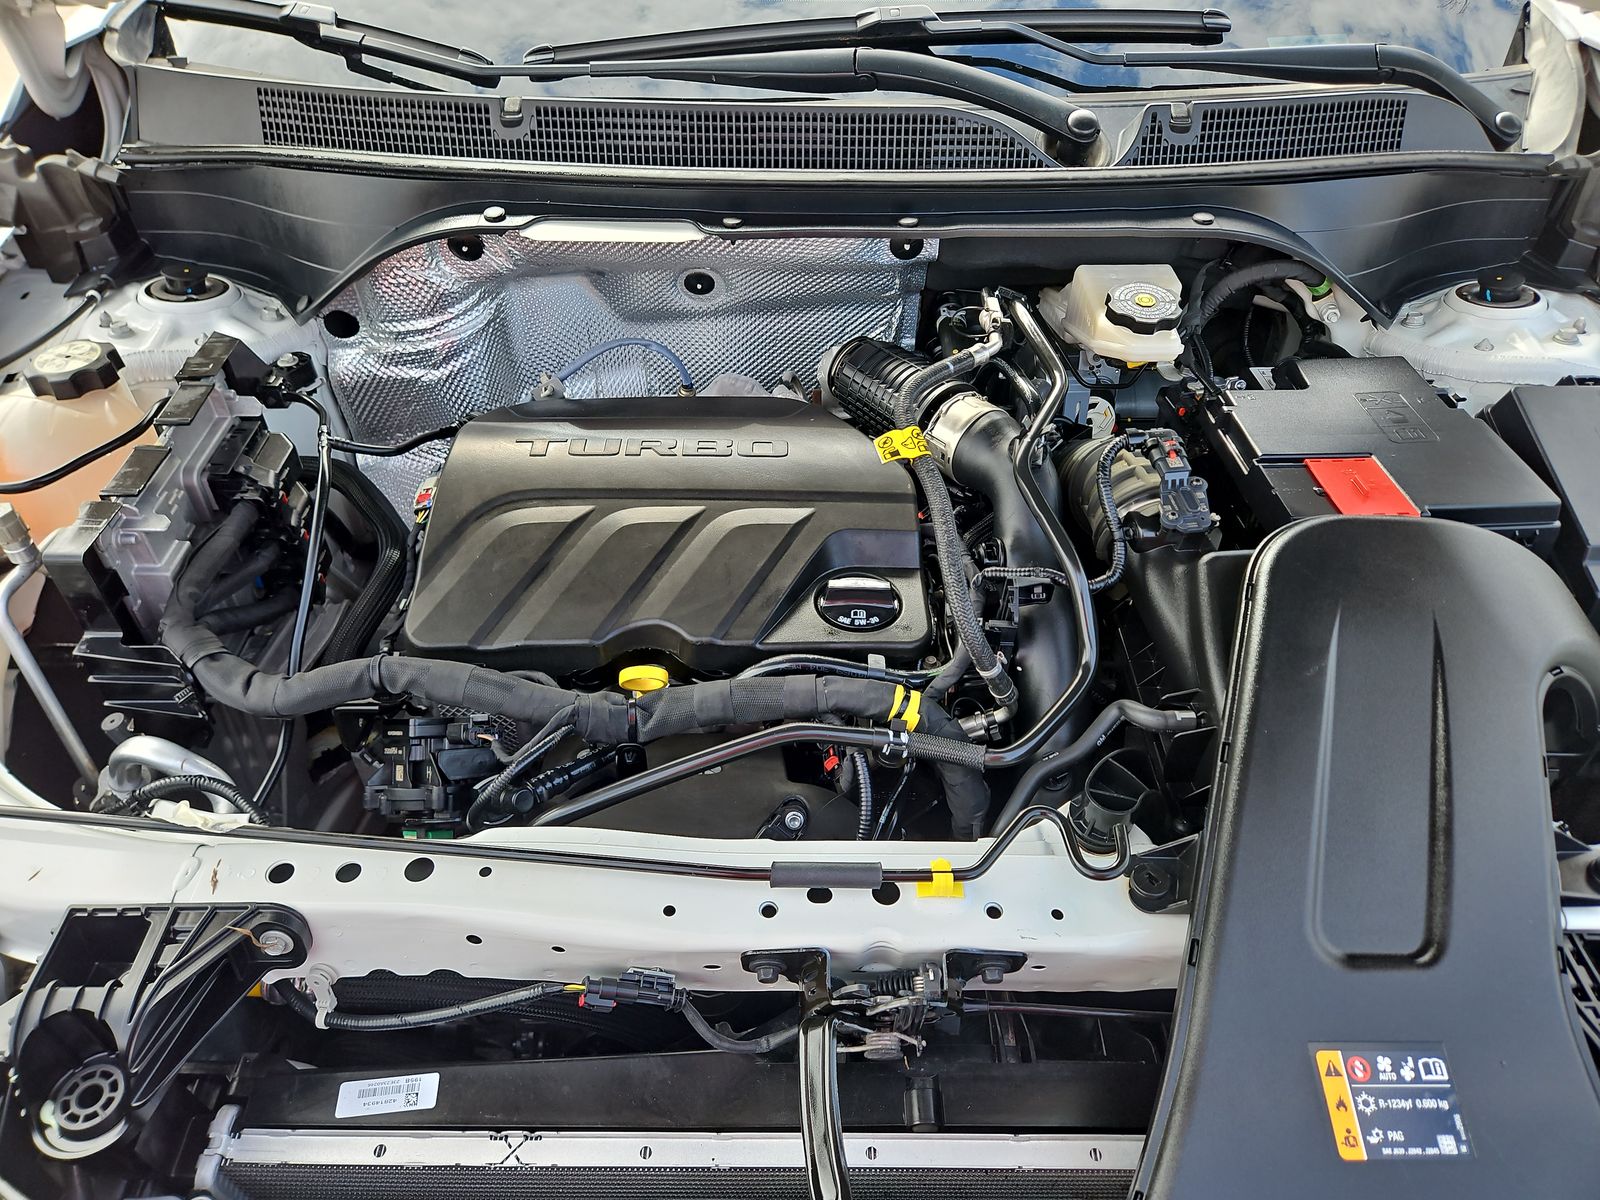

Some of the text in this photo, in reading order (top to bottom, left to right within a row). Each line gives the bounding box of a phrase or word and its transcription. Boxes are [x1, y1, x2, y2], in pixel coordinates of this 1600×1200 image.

[515, 438, 789, 457] TURBO
[837, 615, 880, 626] SAE 5W-30
[1379, 1072, 1397, 1081] AUTO
[1378, 1098, 1413, 1111] R-1234yf
[1437, 1098, 1450, 1111] kg
[1387, 1130, 1405, 1142] PAG
